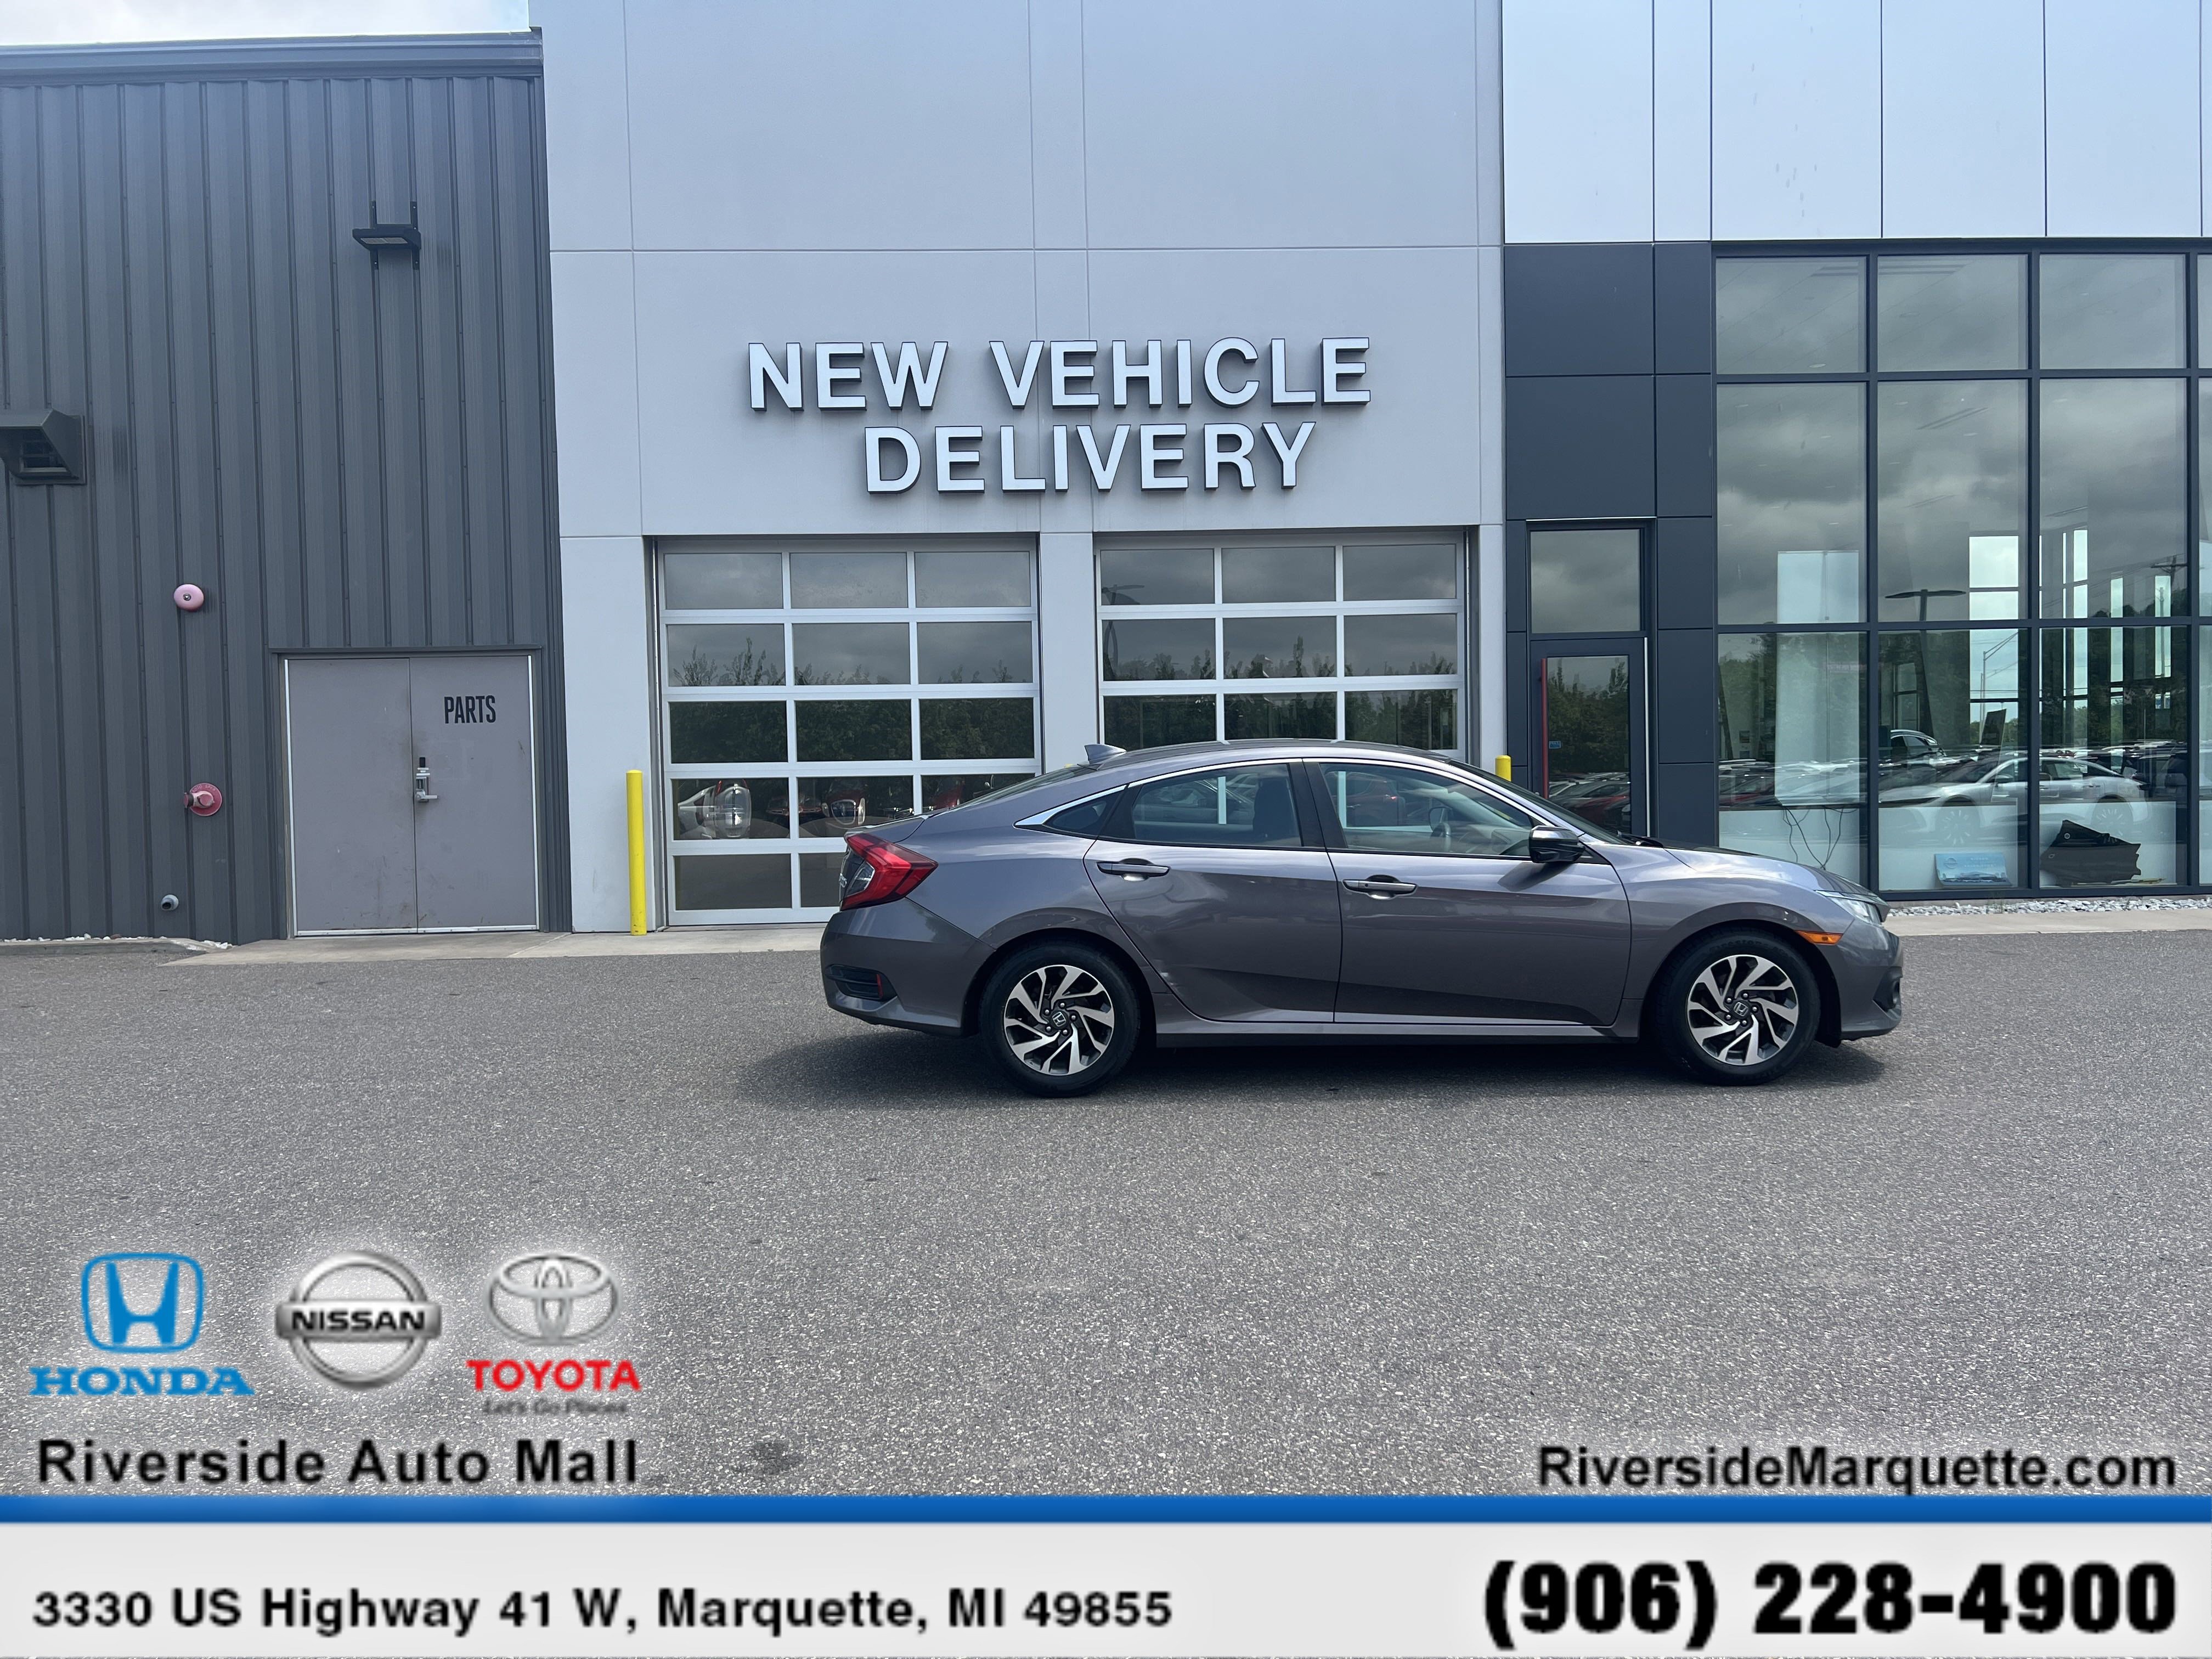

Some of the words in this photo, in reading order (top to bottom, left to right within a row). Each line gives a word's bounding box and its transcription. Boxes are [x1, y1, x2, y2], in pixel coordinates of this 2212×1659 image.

[748, 341, 948, 410] NEW
[989, 337, 1372, 409] VEHICLE
[865, 422, 1316, 494] DELIVERY
[444, 695, 496, 724] PARTS
